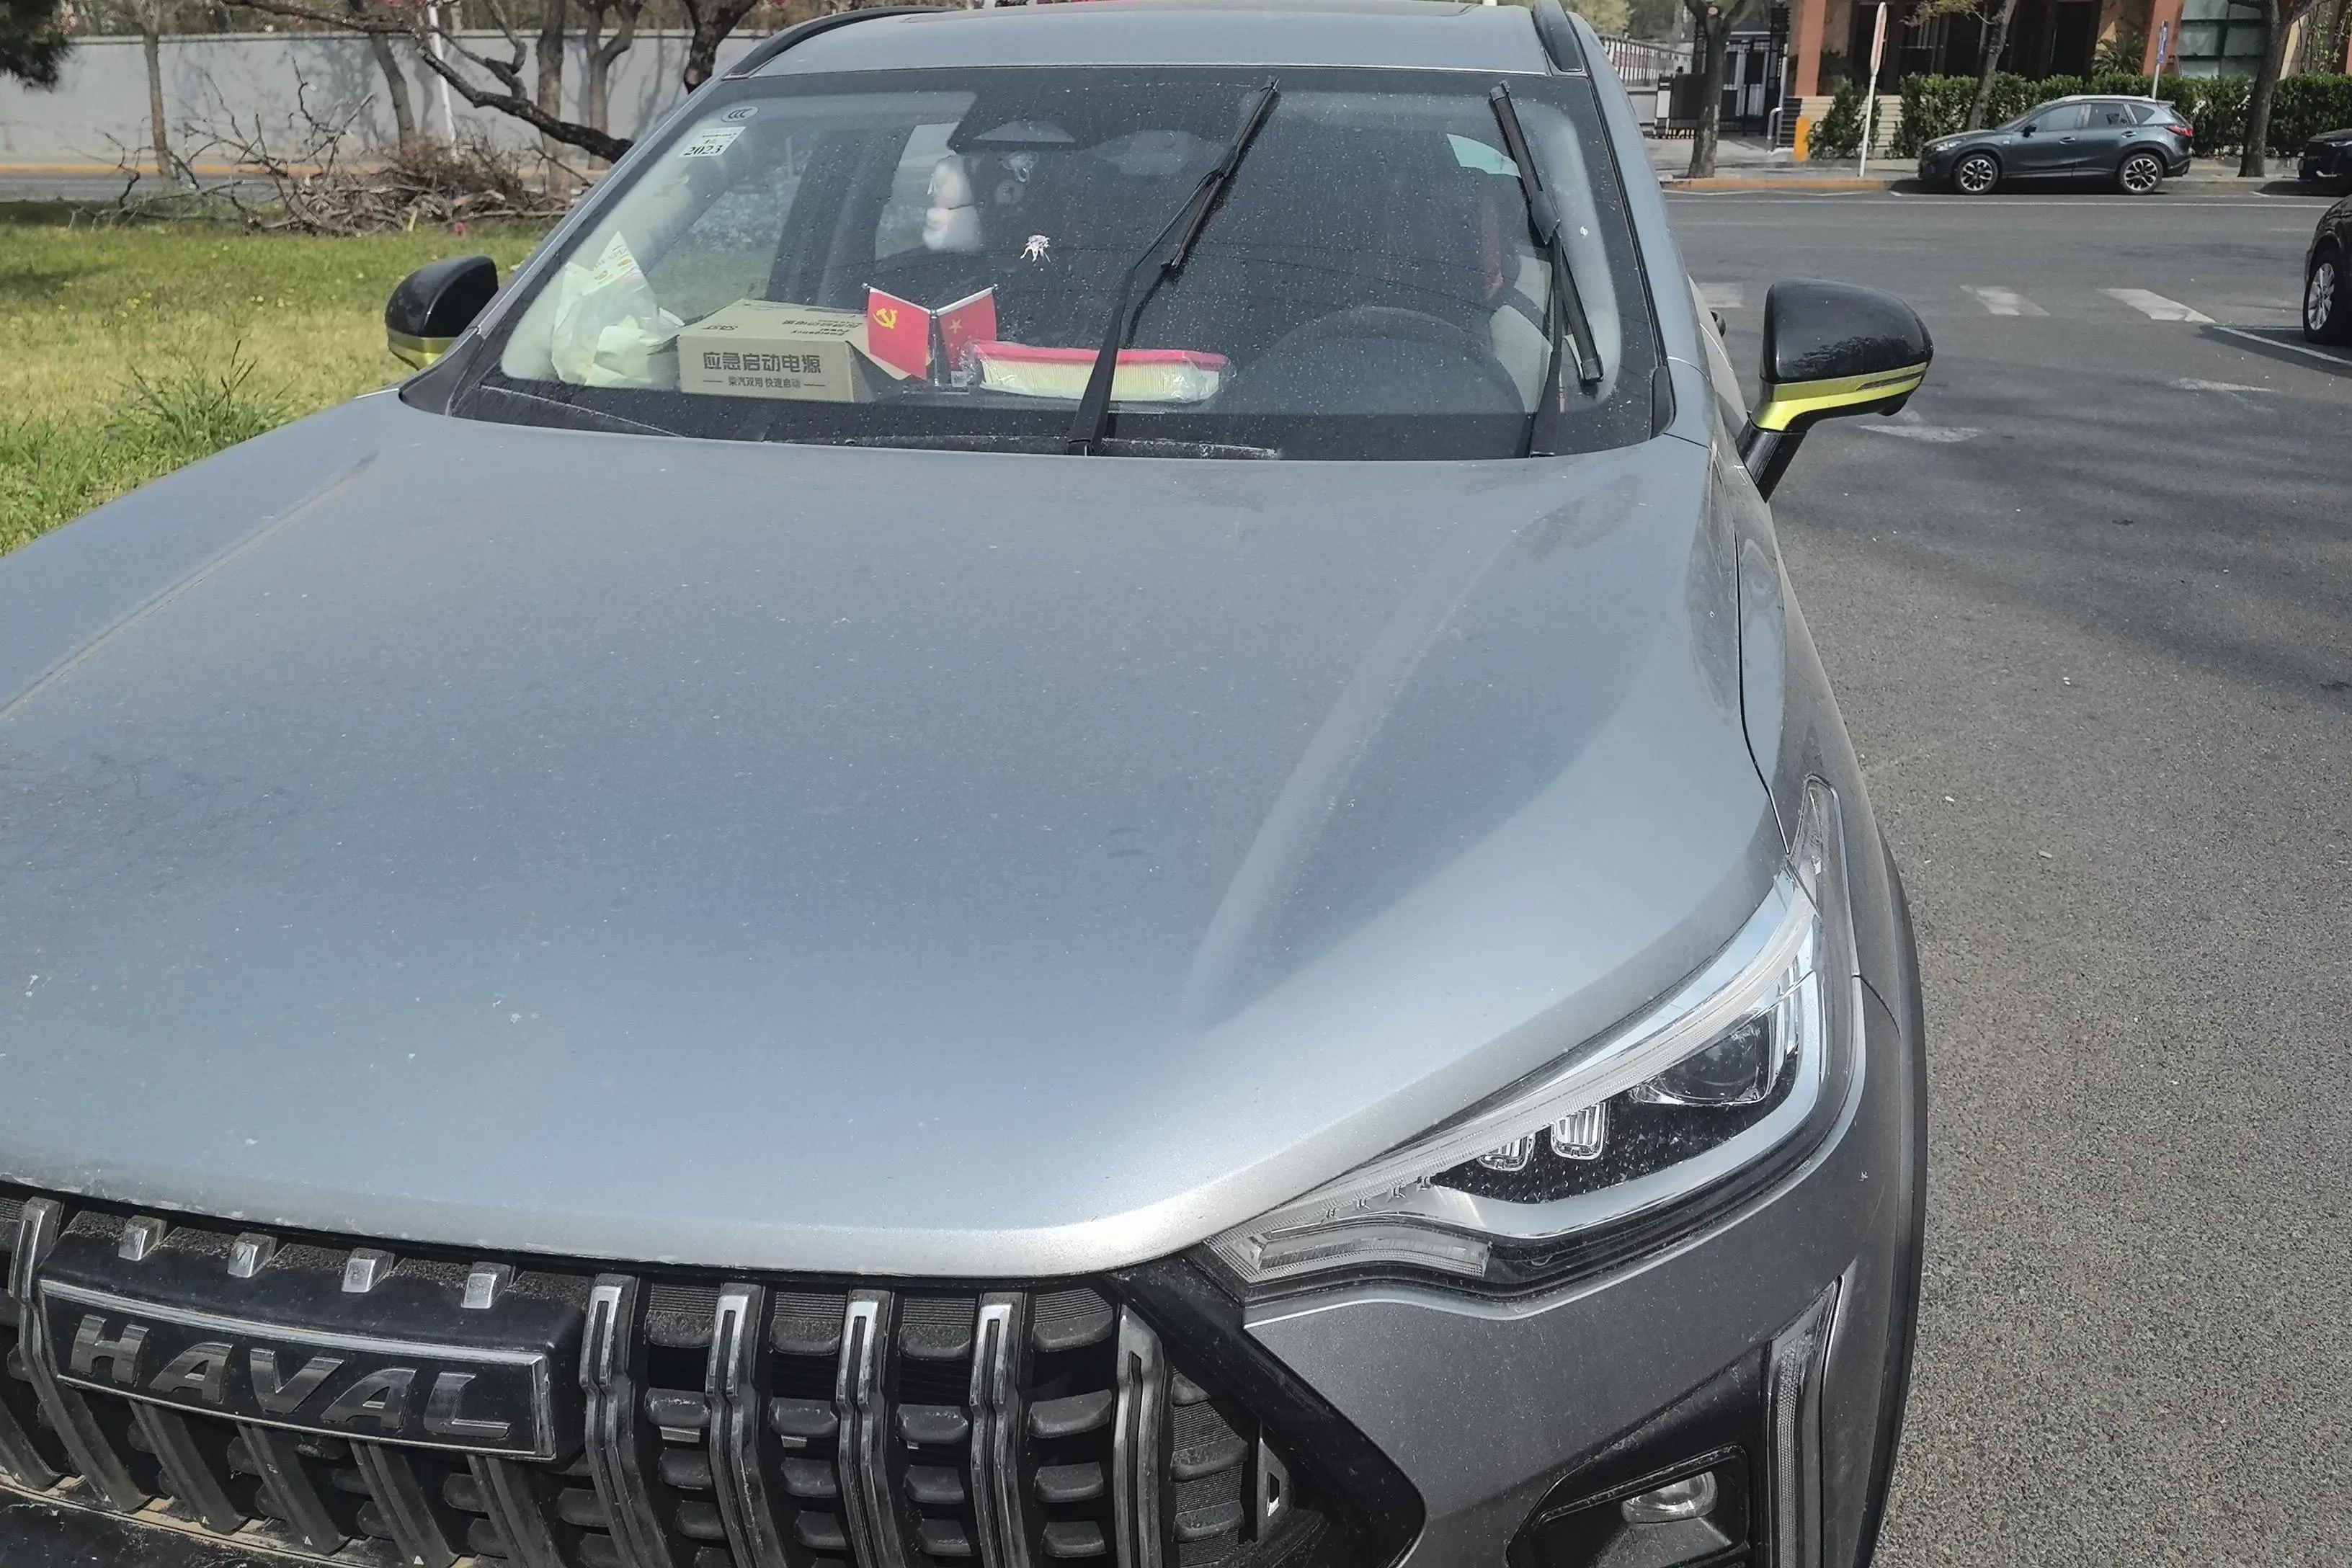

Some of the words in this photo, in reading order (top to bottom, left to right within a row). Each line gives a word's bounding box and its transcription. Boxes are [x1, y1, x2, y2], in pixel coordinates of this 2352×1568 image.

[684, 145, 723, 156] 2023
[703, 352, 821, 373] 应急启动电源
[70, 1314, 511, 1438] HAVAL
